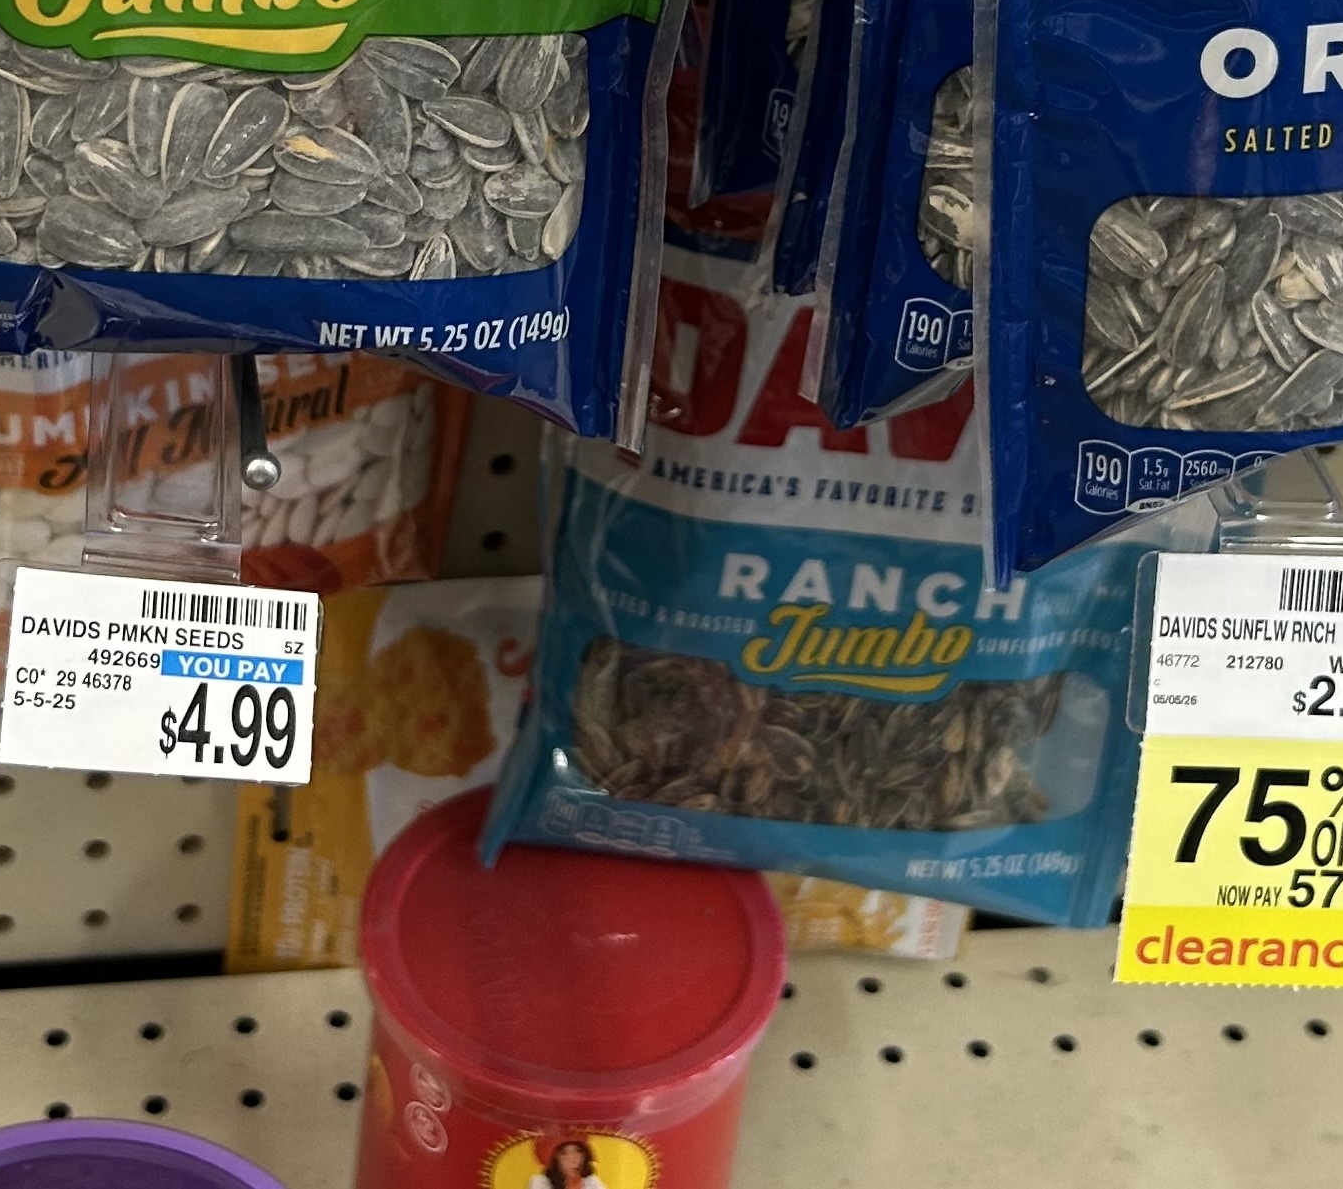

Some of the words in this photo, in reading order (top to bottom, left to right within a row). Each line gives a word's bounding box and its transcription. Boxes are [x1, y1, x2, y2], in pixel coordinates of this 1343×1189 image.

[1224, 122, 1333, 154] SALTED
[319, 321, 368, 349] NET
[419, 323, 470, 353] 5.25
[473, 319, 505, 350] OZ
[508, 305, 570, 351] (149g)
[907, 311, 944, 347] 190
[904, 340, 939, 359] Calories
[1084, 452, 1123, 486] 190
[814, 477, 940, 513] FAVORITE
[1084, 481, 1120, 500] Calories
[718, 551, 1029, 622] RANCH
[21, 616, 101, 640] DAVIDS
[107, 623, 169, 646] PMKN
[174, 628, 244, 651] SEEDS
[283, 640, 304, 655] 5Z
[742, 601, 975, 674] Jumbo
[1158, 615, 1218, 640] DAVIDS
[1221, 618, 1288, 642] SUNFLW
[1291, 622, 1337, 645] RNCH
[87, 648, 161, 670] 492669
[177, 654, 231, 679] YOU
[237, 659, 288, 683] PAY
[1156, 654, 1200, 669] 46772
[1226, 655, 1284, 671] 212780
[81, 672, 132, 692] 46378
[1152, 694, 1198, 707] 05/05/26
[13, 691, 77, 710] 5-5-25
[159, 681, 298, 769] $4.99
[1216, 885, 1252, 907] NOW
[1254, 886, 1283, 908] PAY
